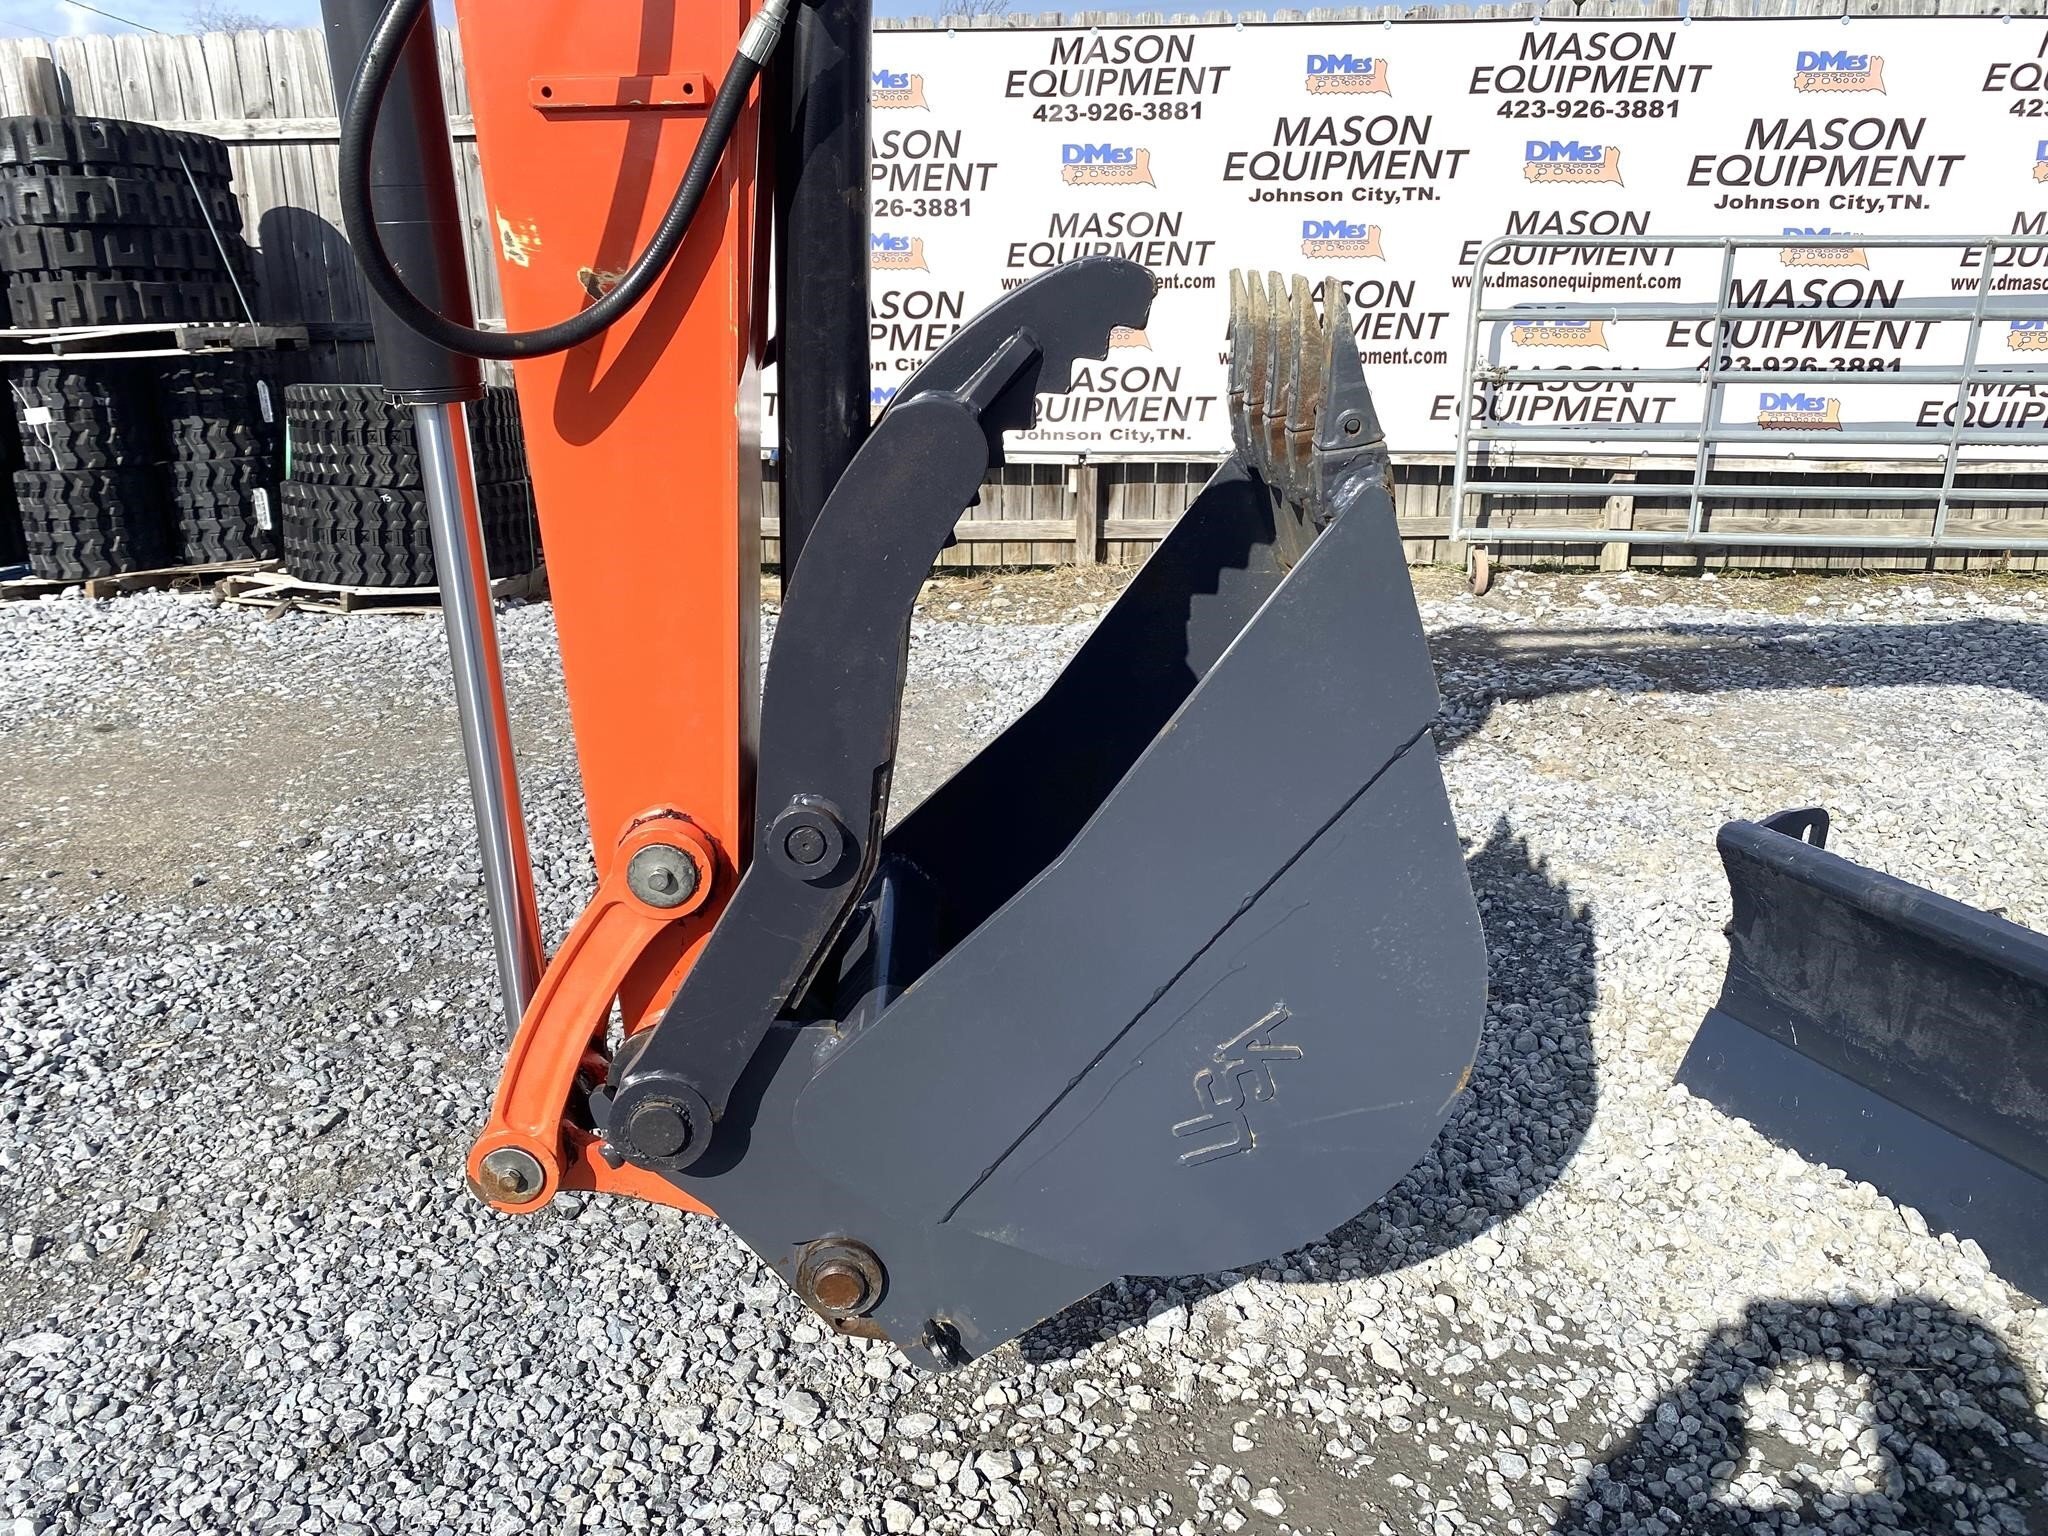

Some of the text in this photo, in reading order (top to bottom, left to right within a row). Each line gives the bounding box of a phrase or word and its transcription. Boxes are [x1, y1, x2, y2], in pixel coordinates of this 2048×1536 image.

[1050, 34, 1195, 65] MASON
[1519, 32, 1676, 61] MASON
[1005, 66, 1231, 98] EQUIPMENT
[1469, 64, 1712, 94] EQUIPMENT
[1033, 101, 1202, 122] 423-926-3881
[1497, 99, 1680, 119] 423-926-3881
[872, 130, 961, 159] SON
[1273, 115, 1432, 147] MASON
[1745, 118, 1926, 150] MASON
[872, 163, 998, 191] PMENT
[1223, 149, 1470, 181] EQUIPMENT
[1687, 155, 1966, 187] EQUIPMENT
[872, 198, 971, 217] 26-3881
[1249, 187, 1343, 202] Johnson
[1714, 194, 1819, 209] Johnson
[1048, 212, 1182, 238] MASON
[1505, 210, 1650, 235] MASON
[871, 291, 964, 319] SON
[1728, 279, 1904, 308] MASON
[1072, 367, 1181, 393] ASON
[1036, 396, 1217, 422] UIPMENT
[1430, 395, 1676, 423] EQUIPMENT
[1015, 428, 1102, 441] Johnson
[1172, 1001, 1303, 1168] USA
